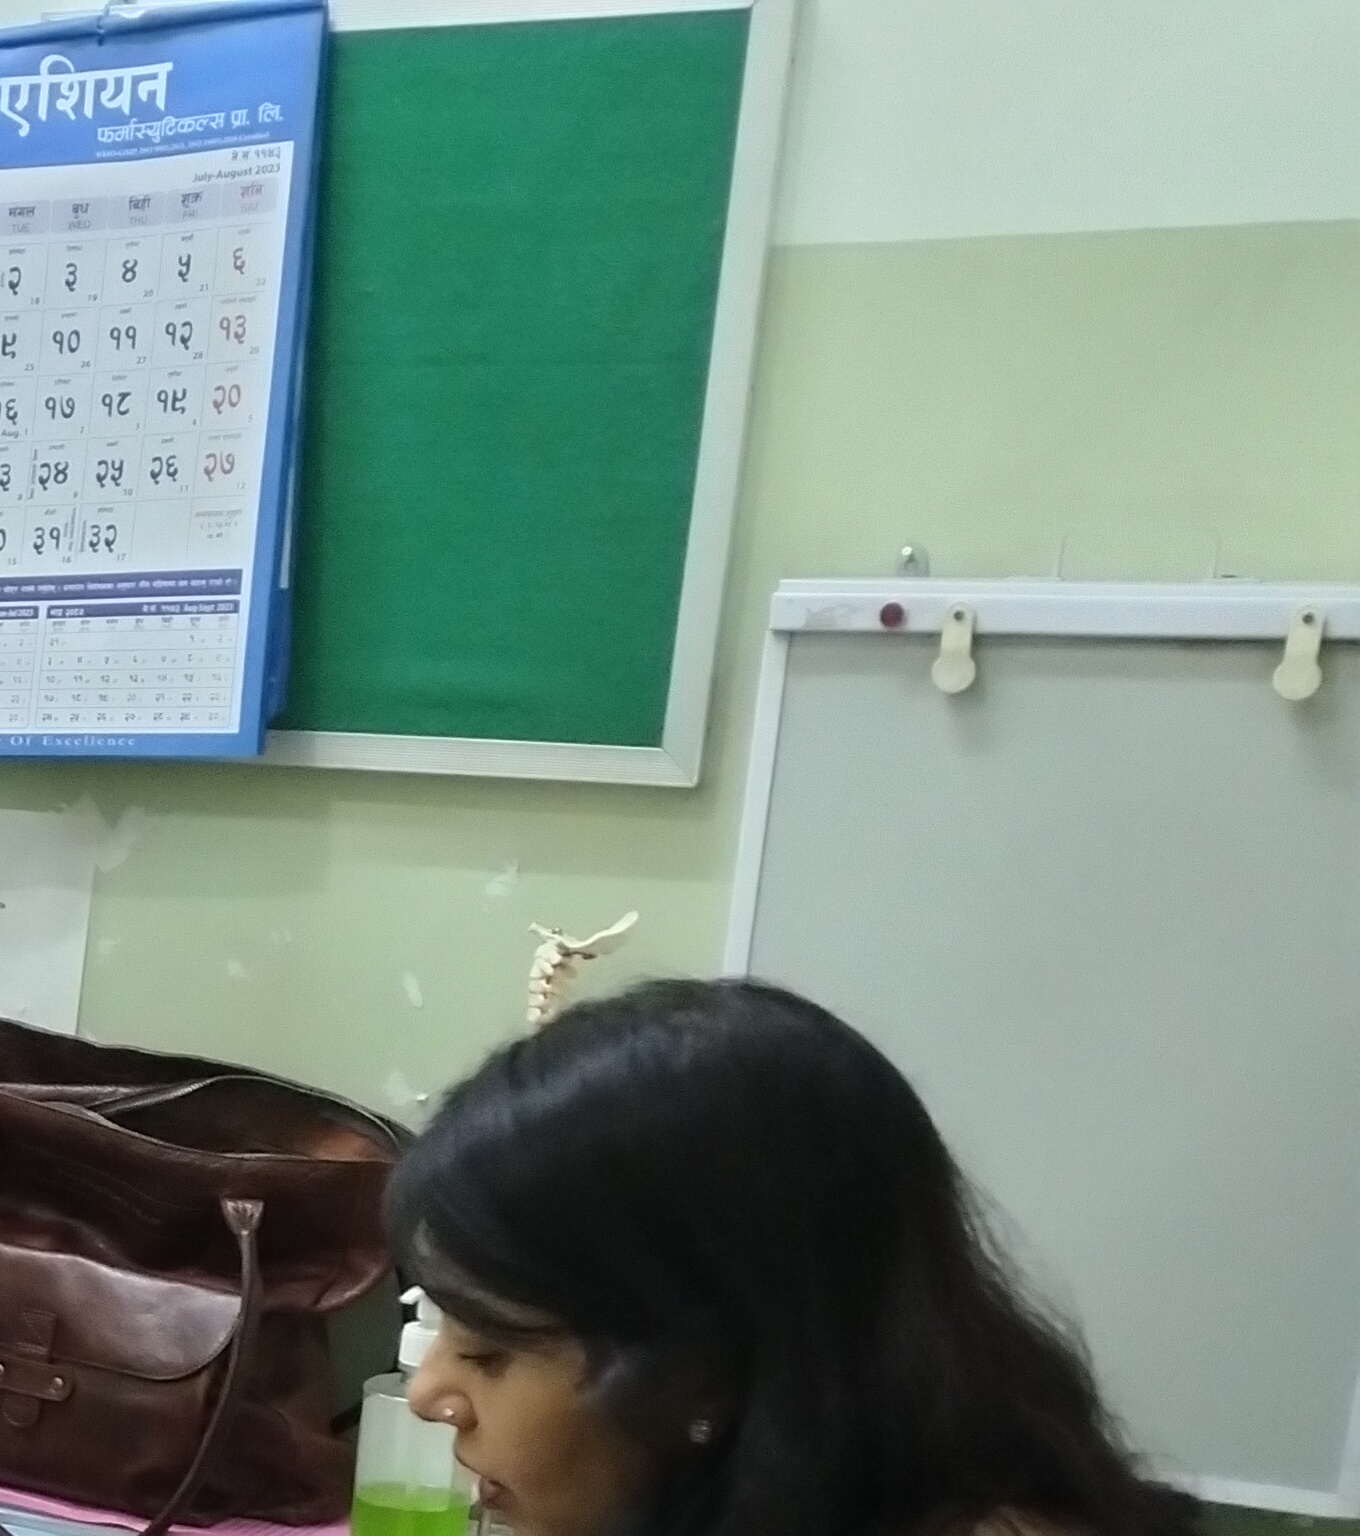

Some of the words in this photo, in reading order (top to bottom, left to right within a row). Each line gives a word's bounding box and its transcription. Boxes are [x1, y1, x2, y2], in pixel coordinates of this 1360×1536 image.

[0, 54, 173, 137] एशियन
[192, 166, 253, 183] July-August
[255, 162, 281, 175] 2023
[8, 266, 22, 295] २
[65, 263, 78, 292] ३
[122, 259, 138, 283] ४
[178, 253, 191, 282] ५
[233, 247, 246, 275] ६
[1, 333, 17, 359] ९
[52, 329, 80, 355] १०
[109, 325, 137, 350] ११
[165, 321, 193, 350] १२
[219, 314, 247, 344] १३
[45, 396, 75, 420] १७
[101, 391, 132, 417] १८
[156, 388, 187, 414] १९
[212, 384, 241, 415] २०
[38, 461, 70, 491] २४
[95, 459, 124, 488] २५
[150, 455, 179, 485] २६
[203, 452, 235, 482] २७
[33, 526, 61, 556] ३१
[88, 524, 118, 553] ३२
[10, 735, 31, 746] Of
[42, 735, 137, 747] Excellence
